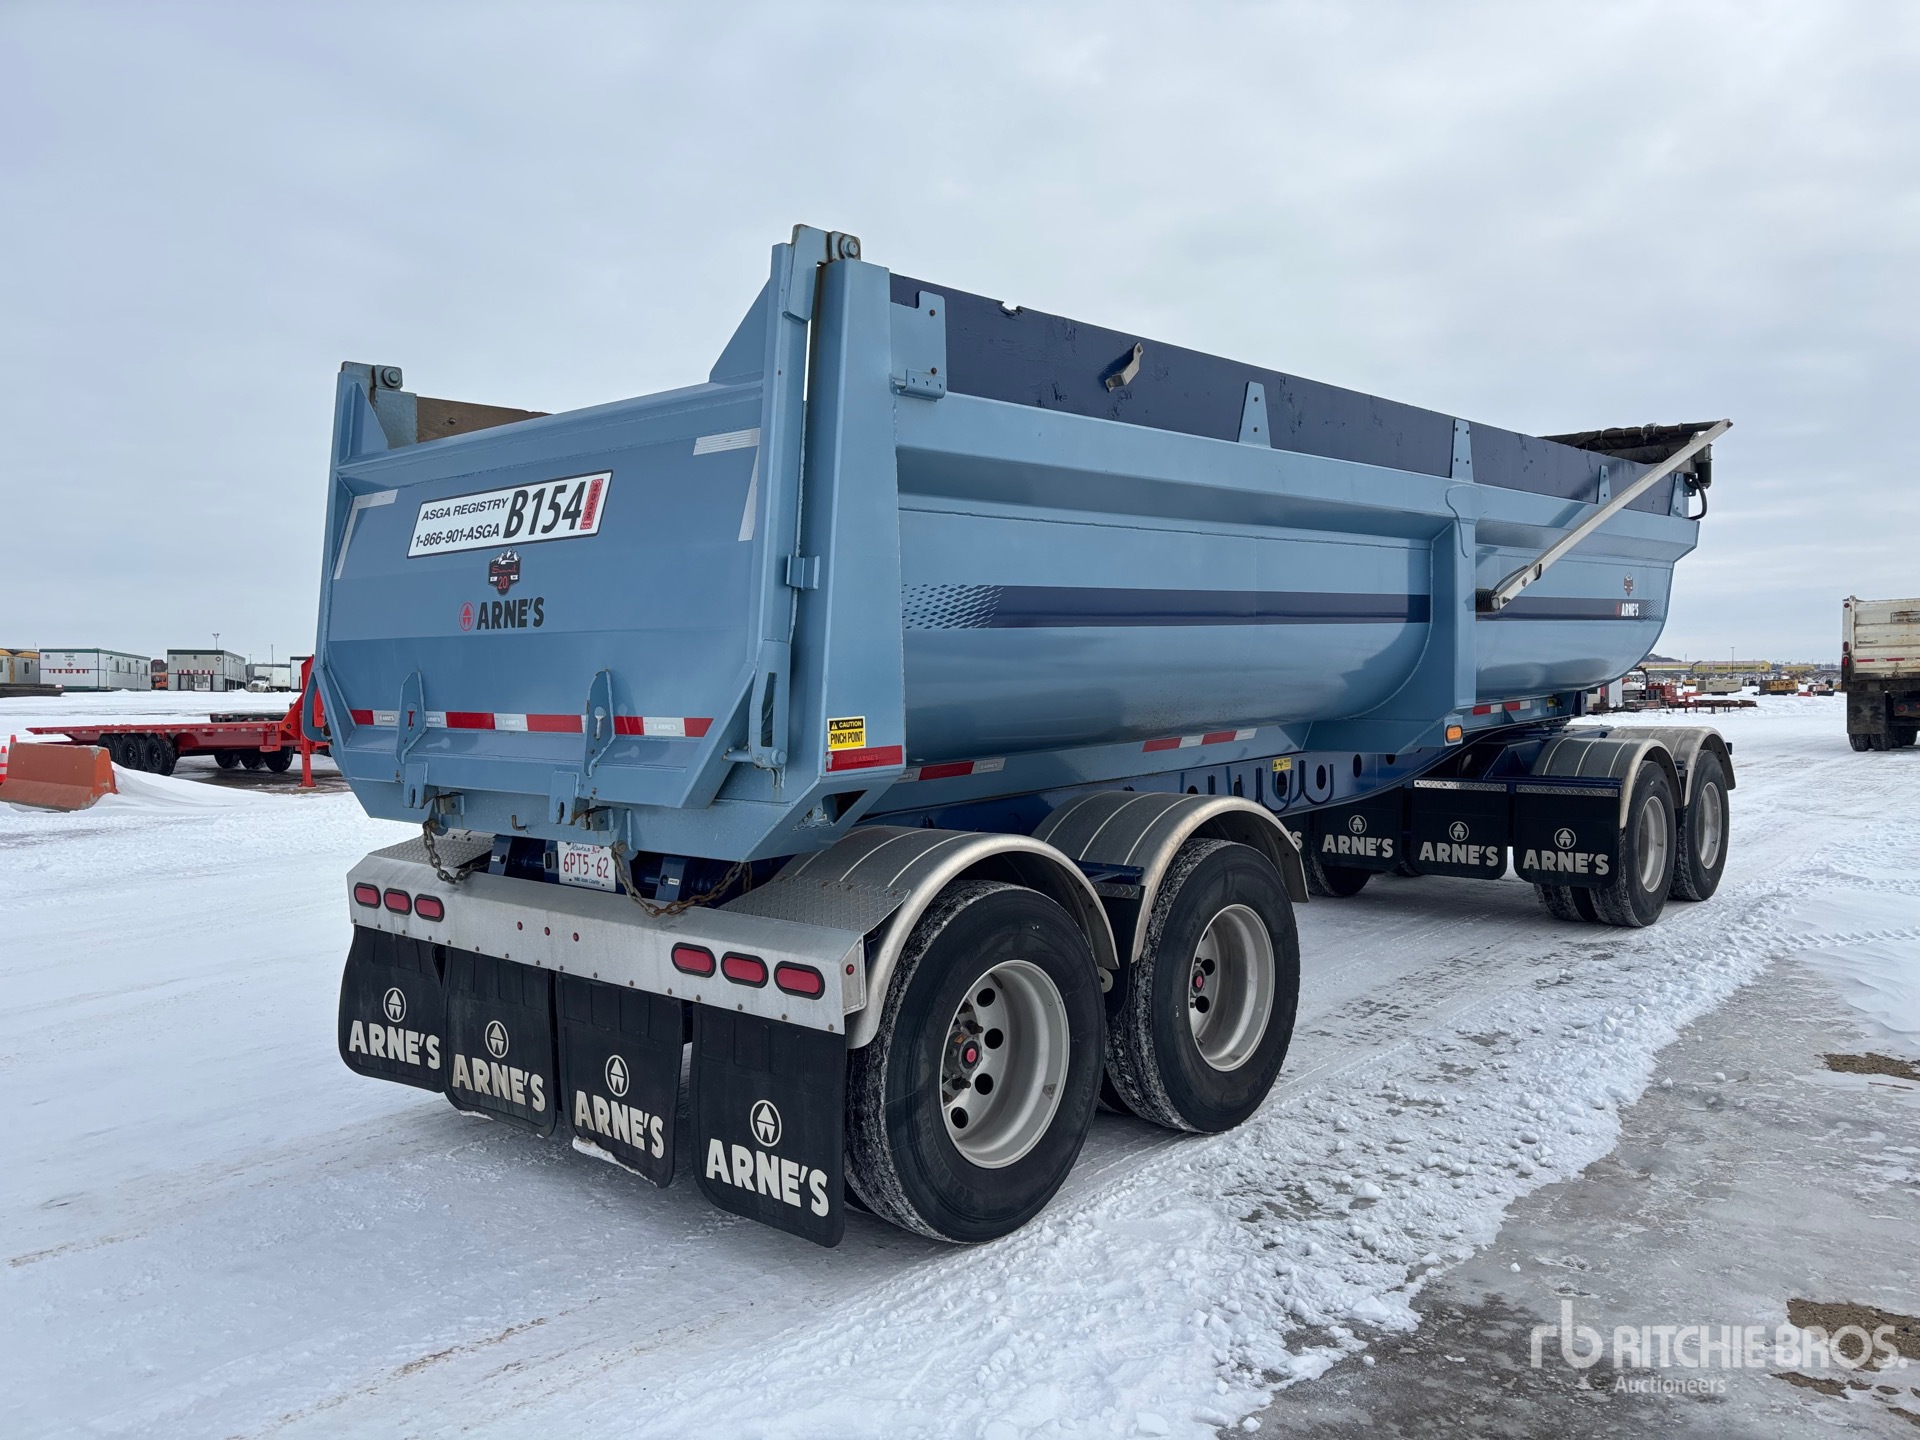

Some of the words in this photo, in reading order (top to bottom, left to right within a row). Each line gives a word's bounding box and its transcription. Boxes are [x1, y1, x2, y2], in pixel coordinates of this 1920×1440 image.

[421, 507, 451, 521] ASGA
[453, 497, 510, 517] REGISTRY
[503, 481, 587, 539] B154
[415, 522, 500, 548] 1-866-901-ASGA
[476, 596, 545, 631] ARNE'S
[838, 720, 862, 728] CAUTION
[830, 732, 846, 745] PINCH
[847, 731, 863, 743] POINT
[1322, 834, 1394, 858] ARNE'S
[1418, 841, 1499, 867] ARNE'S
[1522, 849, 1610, 876] ARNE'S
[348, 1020, 441, 1070] ARNE'S
[452, 1053, 546, 1113] ARNE'S
[575, 1090, 665, 1160] ARNE'S
[705, 1137, 830, 1218] ARNE'S
